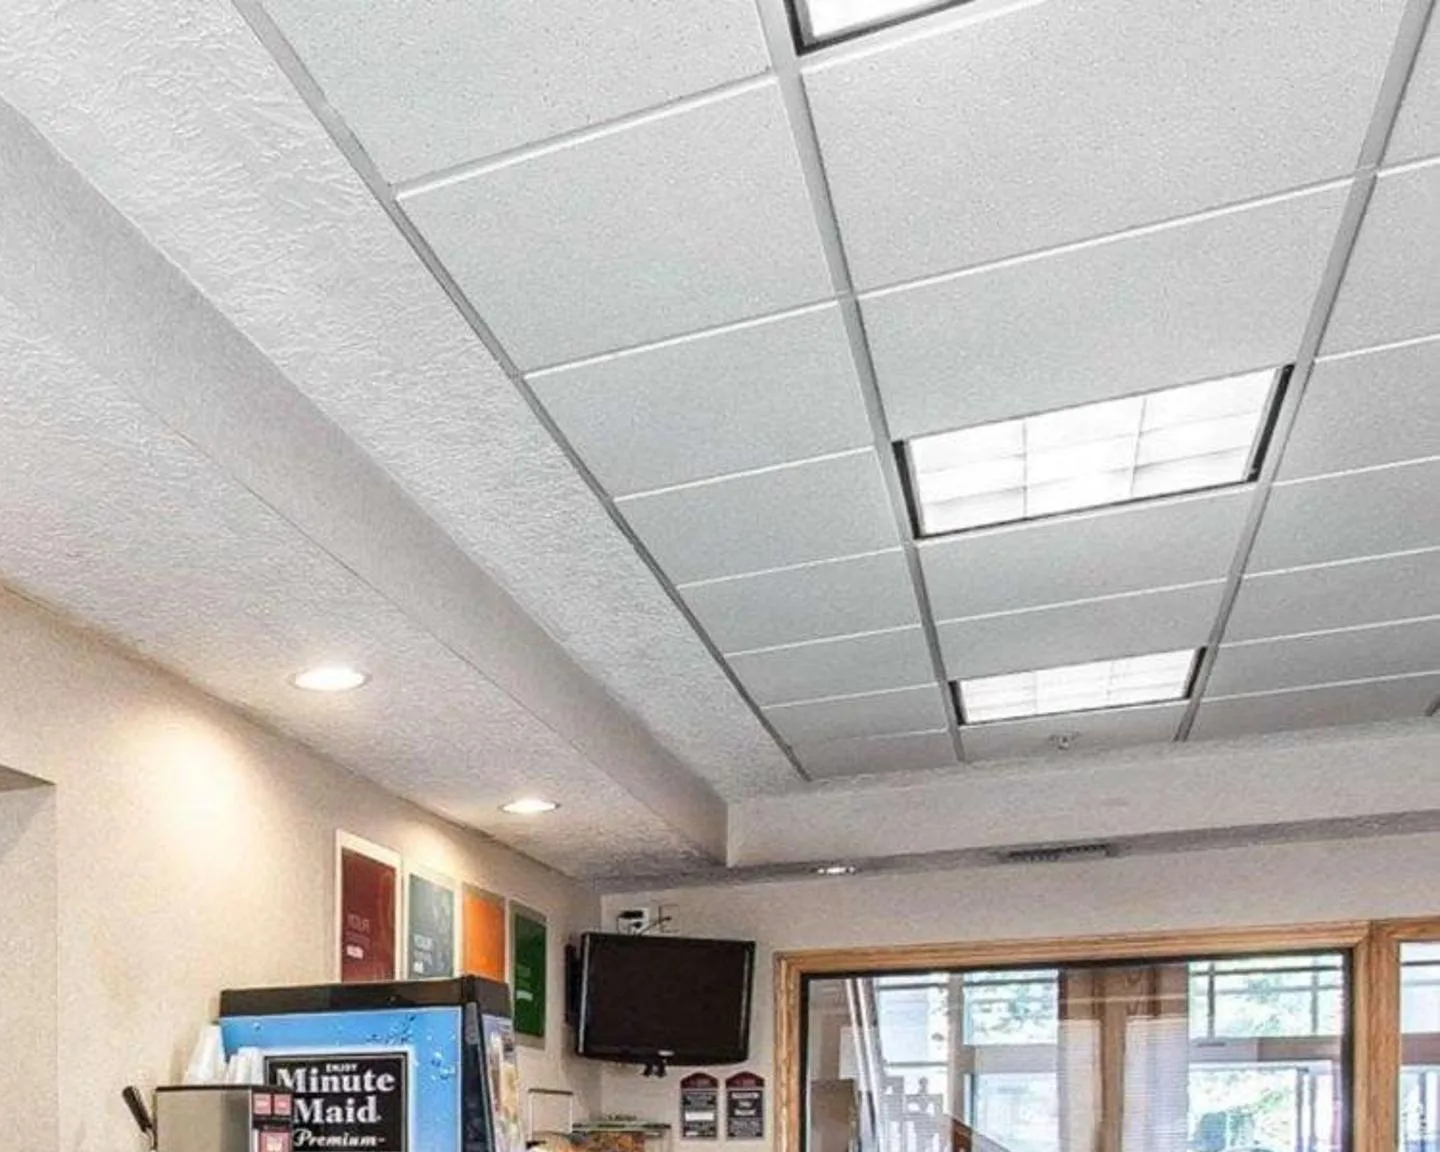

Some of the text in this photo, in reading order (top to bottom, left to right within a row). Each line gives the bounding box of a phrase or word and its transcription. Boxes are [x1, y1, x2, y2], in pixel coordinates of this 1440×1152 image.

[276, 1066, 396, 1093] Minute
[325, 1063, 358, 1073] ENJOY
[293, 1095, 378, 1124] Maid
[293, 1127, 379, 1147] Premium
